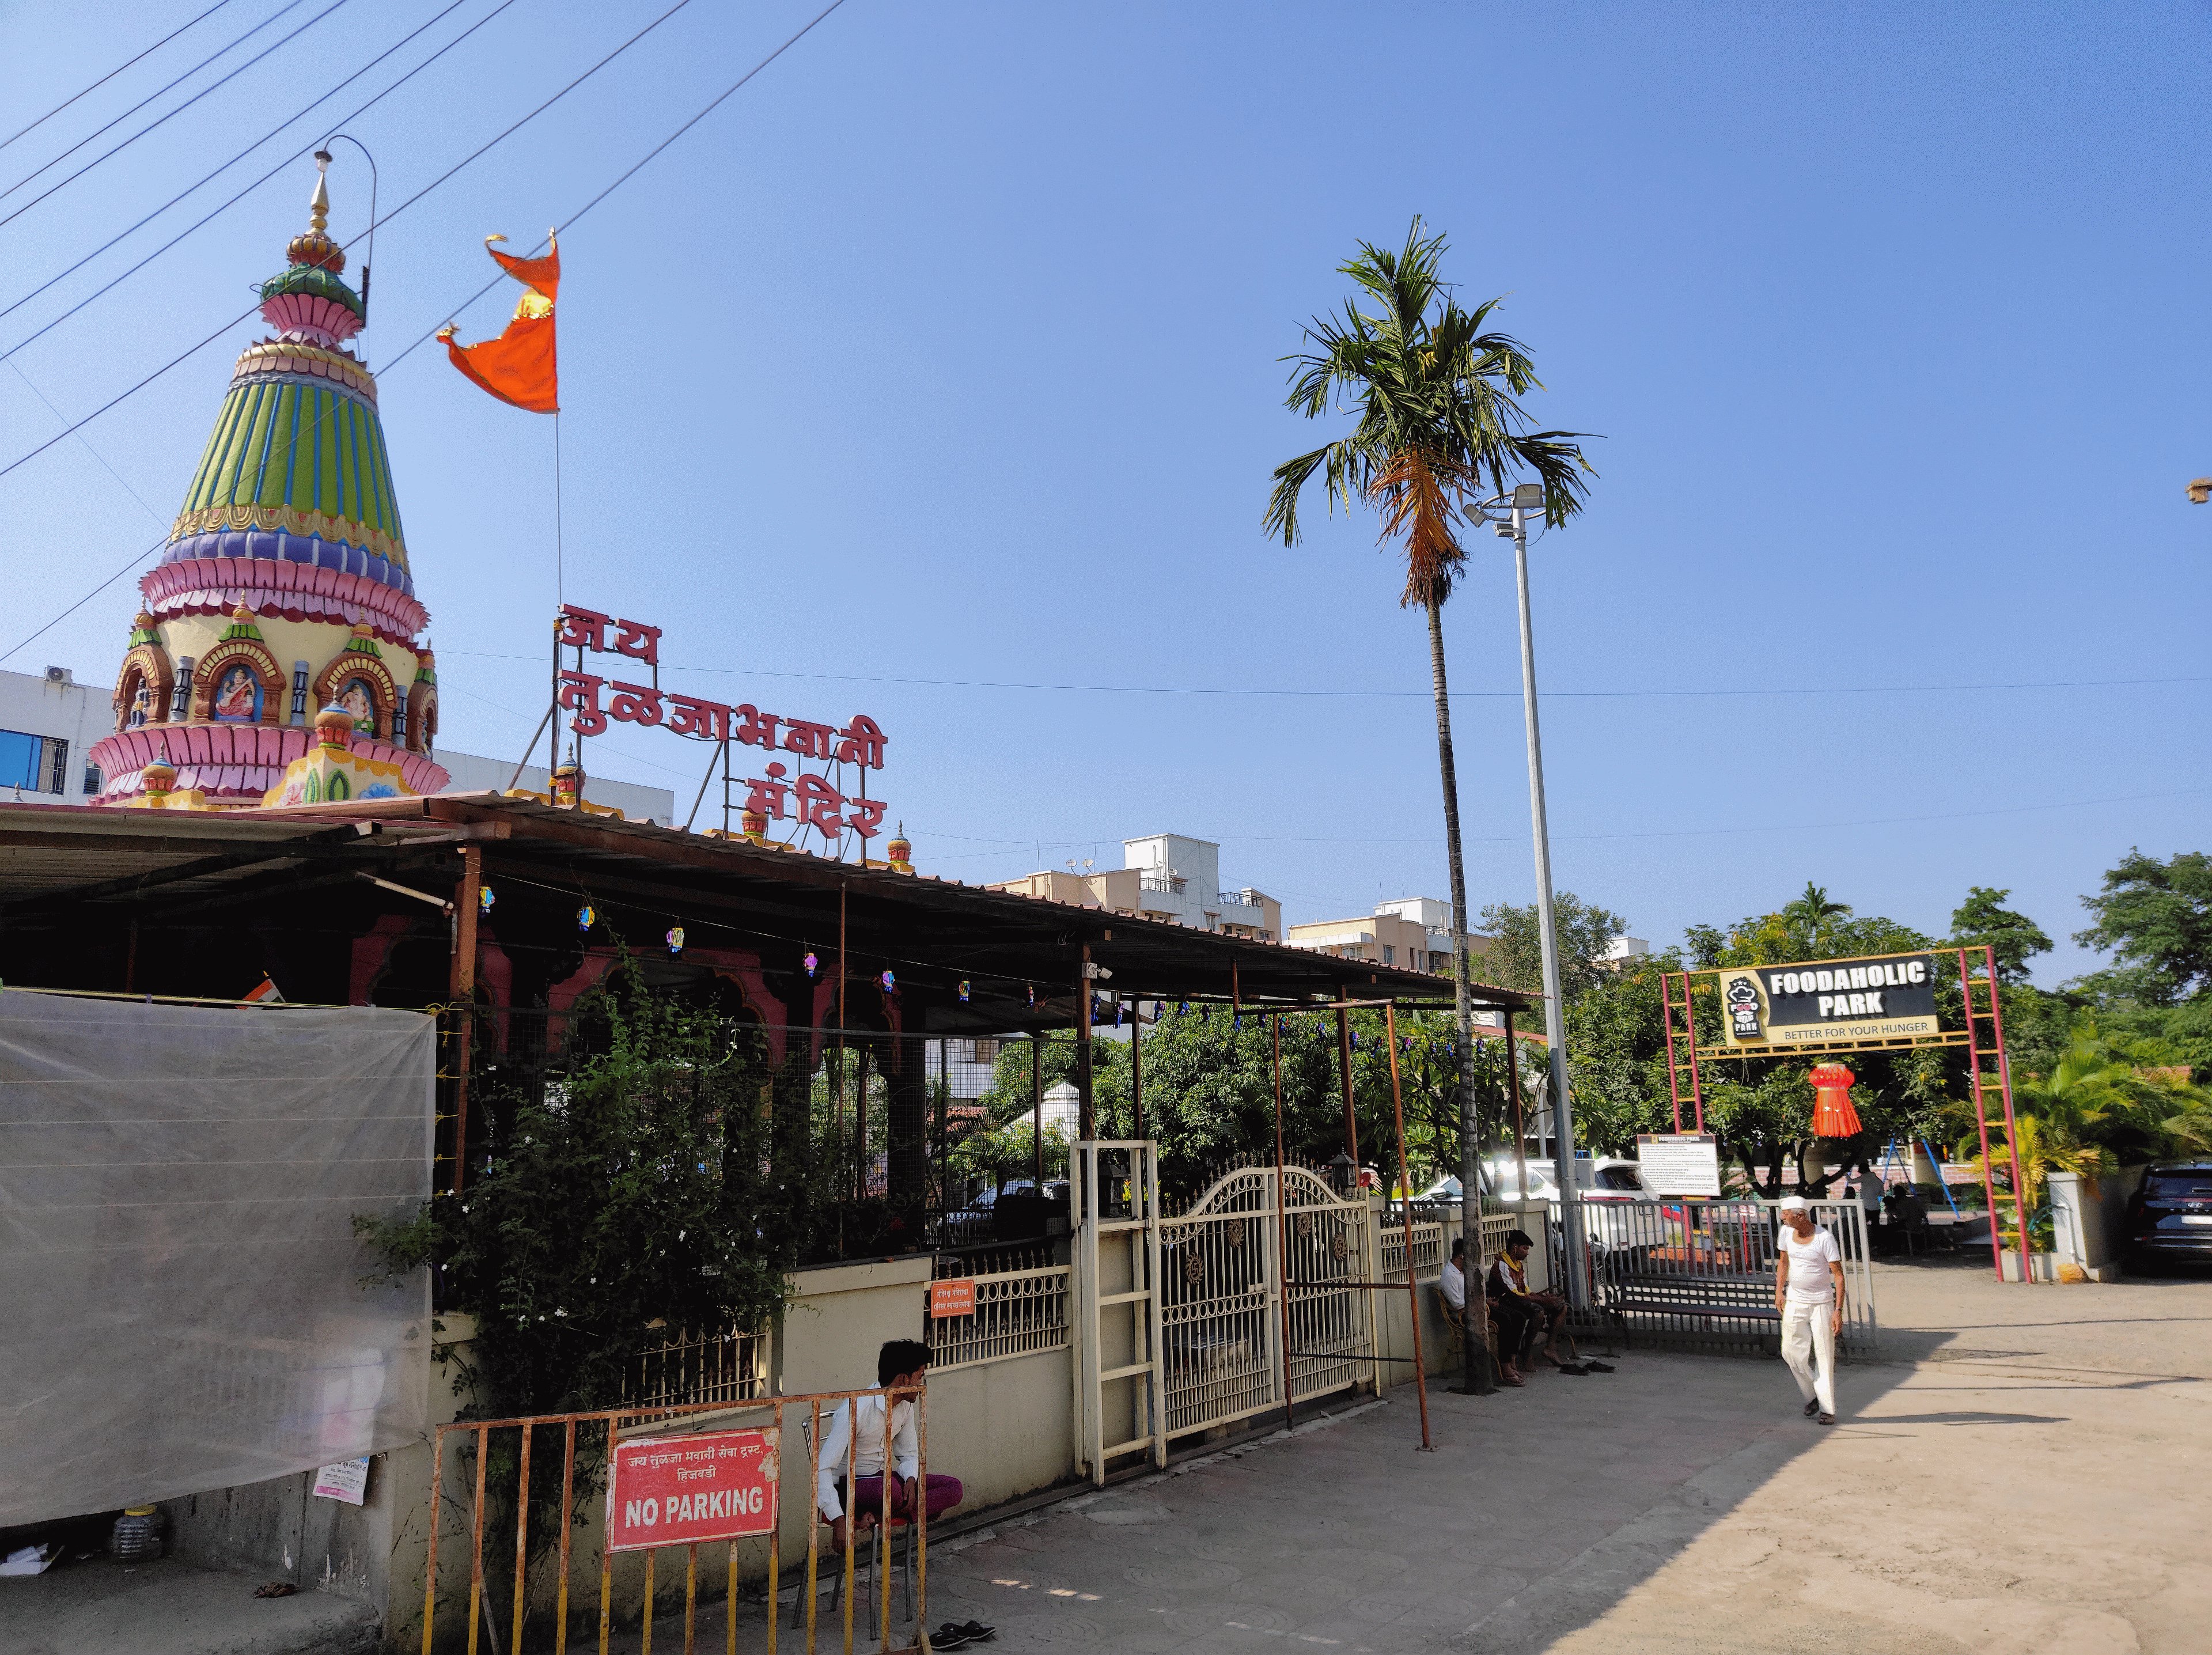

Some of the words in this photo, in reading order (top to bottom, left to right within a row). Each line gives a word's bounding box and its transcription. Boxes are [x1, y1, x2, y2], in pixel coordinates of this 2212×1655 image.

[559, 604, 662, 665] जय
[744, 762, 887, 839] मंदिर
[1770, 961, 1926, 995] FOODAHOLIC
[1818, 991, 1884, 1017] PARK
[1736, 1022, 1757, 1031] PARK
[1785, 1029, 1821, 1040] BETTER
[1825, 1028, 1846, 1037] FOR
[1849, 1025, 1879, 1036] YOUR
[1881, 1022, 1929, 1033] HUNGER
[627, 1456, 647, 1467] जय
[650, 1453, 683, 1469] तुळजा
[685, 1446, 715, 1461] भवानी
[718, 1444, 738, 1459] सेवा
[625, 1498, 659, 1528] NO
[665, 1486, 764, 1524] PARKING
